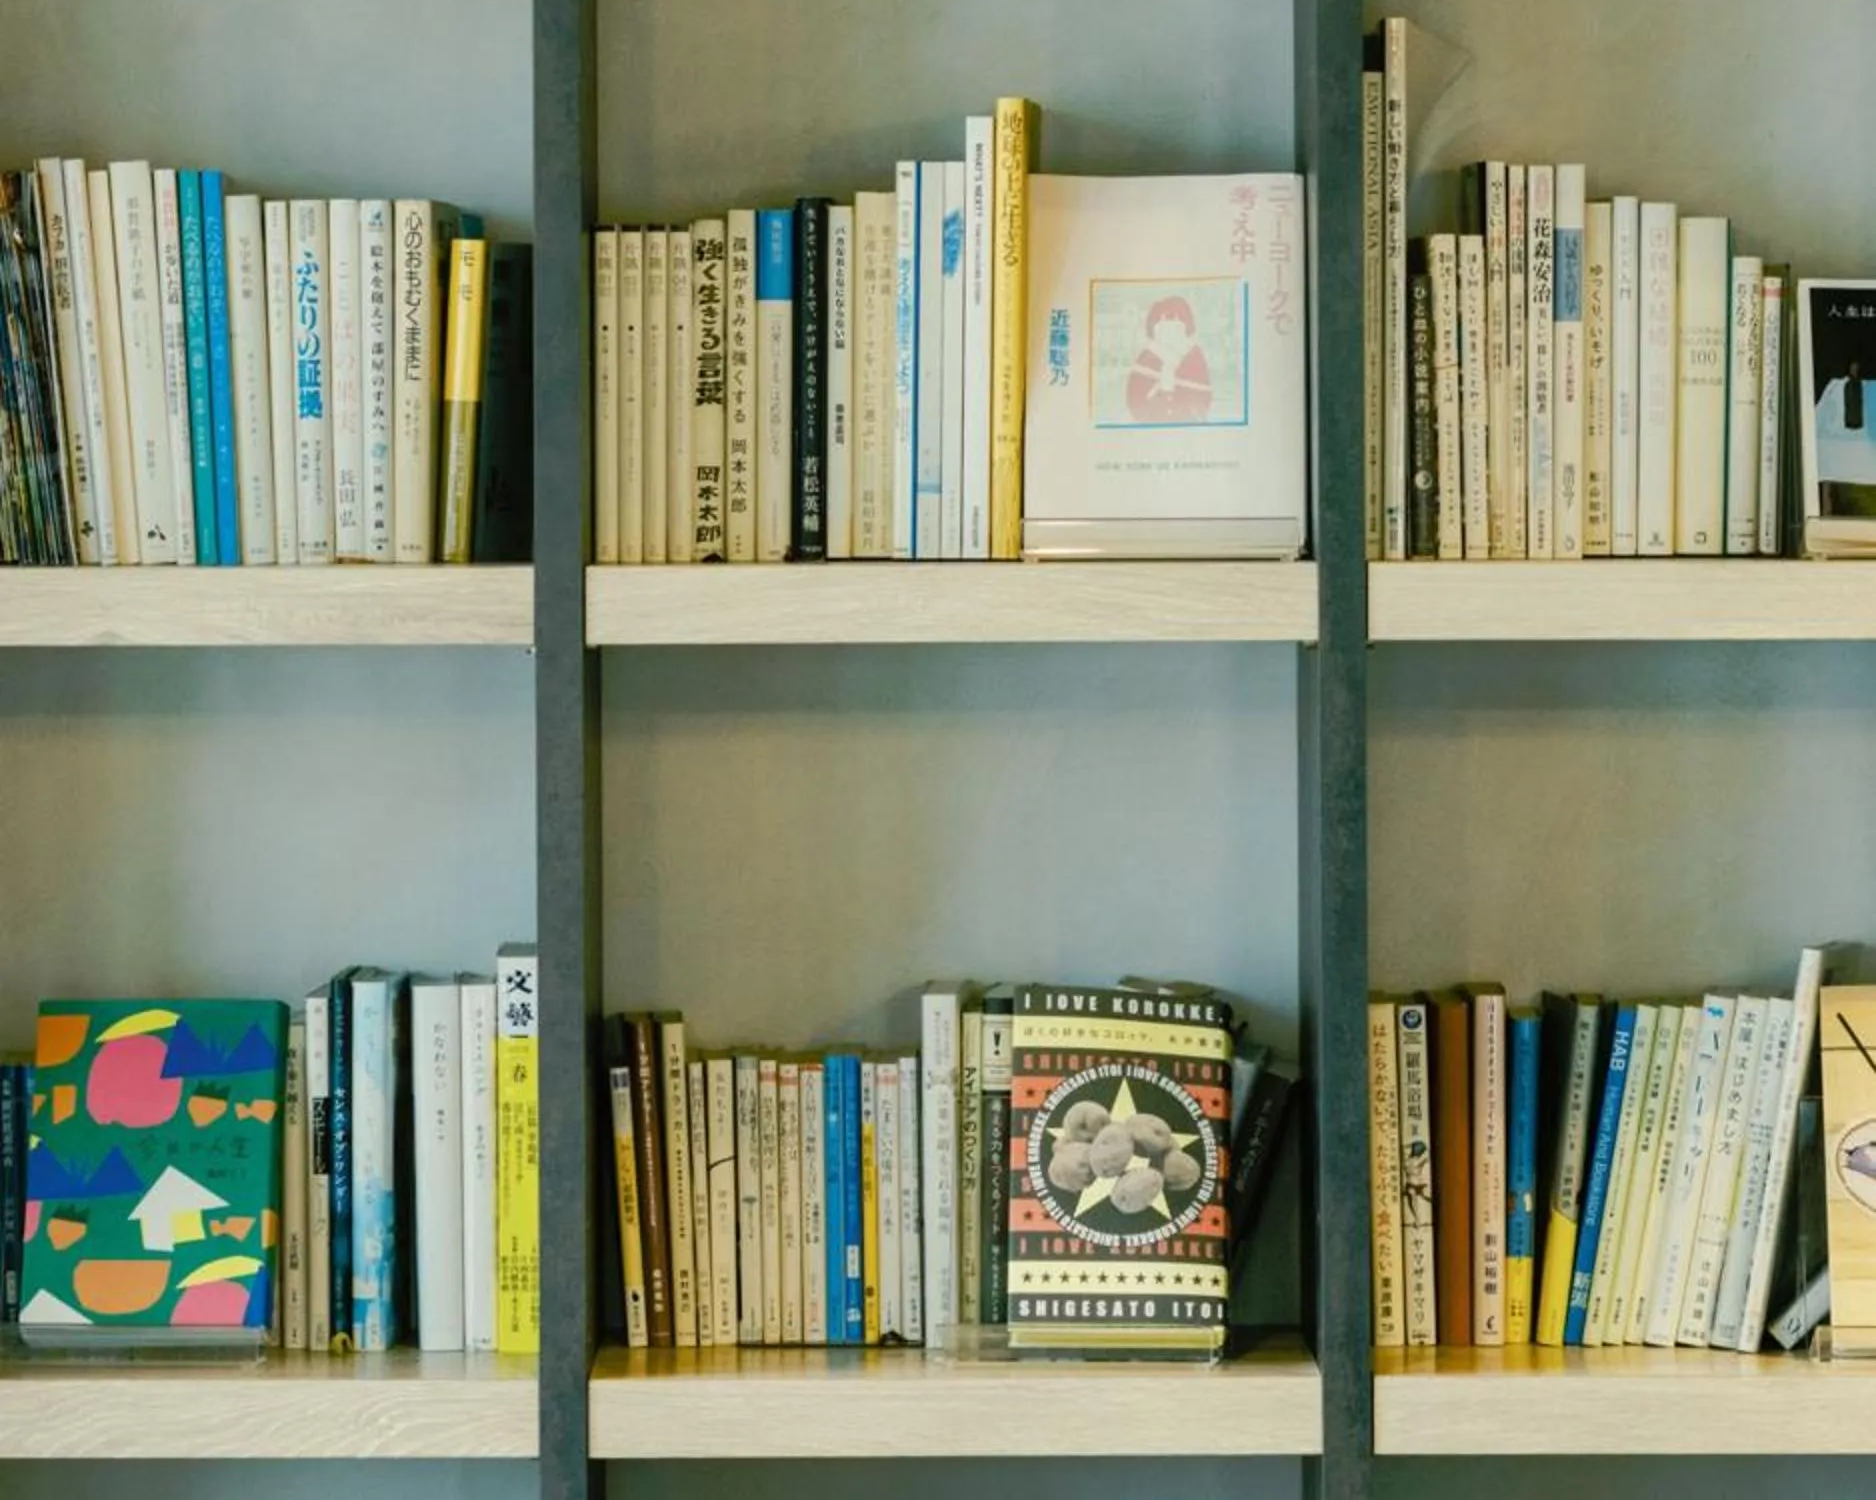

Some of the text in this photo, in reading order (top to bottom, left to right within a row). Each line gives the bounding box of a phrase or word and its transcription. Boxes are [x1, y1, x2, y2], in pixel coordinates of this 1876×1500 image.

[1366, 81, 1380, 250] EMOTIONAL ASIA
[1229, 185, 1256, 263] 考え中
[1266, 185, 1294, 335] ニューヨークで
[1534, 217, 1551, 304] 花森安治
[369, 244, 385, 335] 絵本を抱えて
[404, 210, 424, 382] 心のおもむくままに
[835, 227, 846, 349] バカなおとなにならない脳
[1588, 264, 1604, 369] ゆっくり、いそげ
[297, 250, 323, 419] ふたりの証拠
[731, 237, 748, 514] 孤独がきみを強くする 岡本太郎
[1690, 351, 1717, 365] 100
[371, 343, 386, 432] 部屋のすみへ
[695, 239, 723, 545] 強く生きる言葉 岡本太郎
[339, 469, 357, 528] 長田弘
[802, 456, 820, 533] 若松英輔
[506, 970, 533, 1027] 文藝
[1023, 1027, 1153, 1043] ぼくの好きなコロッケ。
[1025, 994, 1224, 1024] I LOVE KOROKKE.
[513, 1063, 528, 1083] 春
[670, 1043, 683, 1142] 1分間ドラッカー
[1610, 1031, 1630, 1072] HAB
[333, 1086, 346, 1214] センス・オブ・ワンダー
[965, 1066, 977, 1191] アイデアのつくり方
[1601, 1086, 1620, 1131] Human
[1019, 1300, 1223, 1319] SHIGESATO ITOI
[1413, 1239, 1425, 1324] ヤマザキマリ
